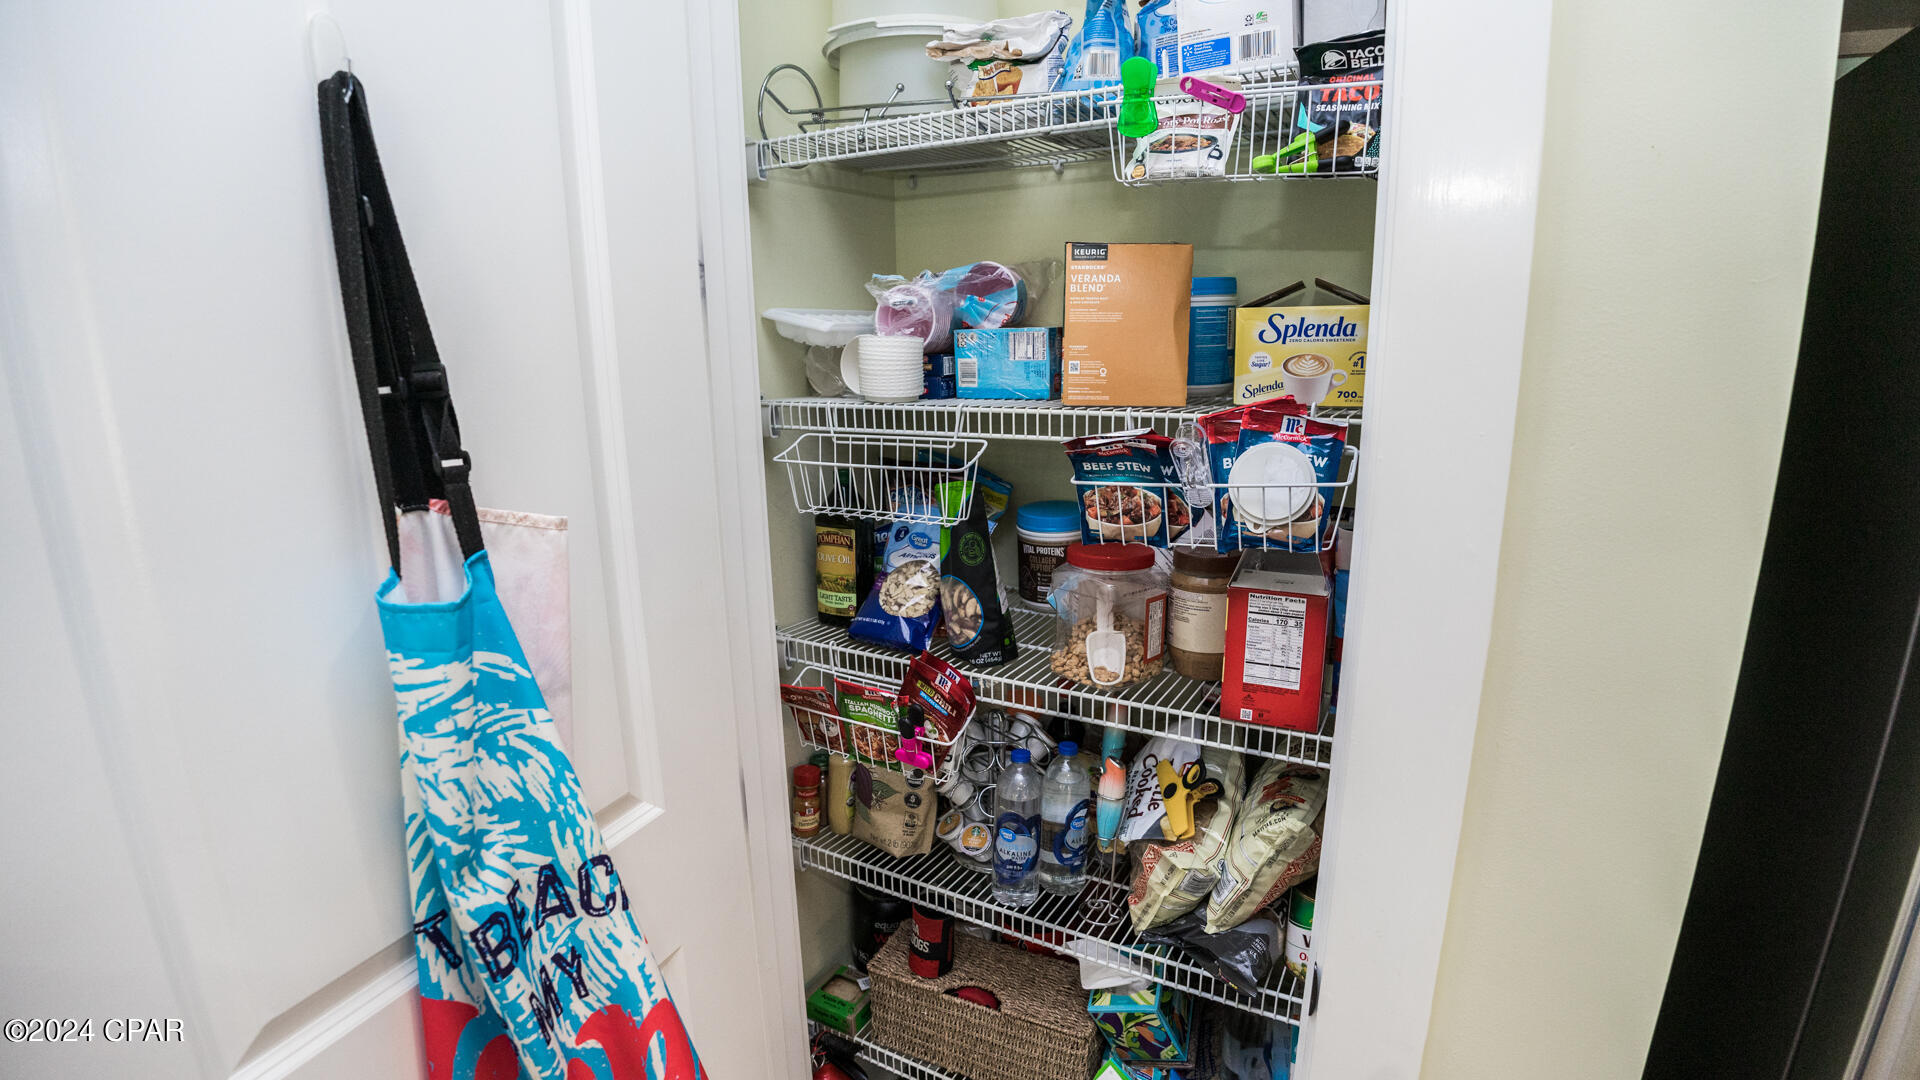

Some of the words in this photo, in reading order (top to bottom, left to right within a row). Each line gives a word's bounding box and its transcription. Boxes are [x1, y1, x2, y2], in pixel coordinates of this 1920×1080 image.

[1347, 45, 1384, 58] TACO
[1351, 58, 1384, 68] BELL
[1329, 73, 1376, 83] ORIGINAL
[1320, 85, 1381, 102] TACO
[1315, 103, 1362, 112] SEASONING
[1070, 273, 1121, 283] VERANDA
[1070, 283, 1104, 292] BLEND
[1258, 313, 1357, 344] Splenda
[1352, 355, 1365, 369] #1
[1242, 380, 1284, 399] Splenda
[1337, 390, 1358, 399] 700
[1274, 433, 1308, 442] McCormick
[1082, 461, 1114, 471] BEEF
[1117, 461, 1151, 473] STEW
[1023, 543, 1035, 554] VITAL
[1036, 544, 1065, 558] PROTEINS
[817, 552, 837, 563] OLIVE
[837, 554, 851, 564] OIL
[1029, 555, 1057, 565] COLLAGEN
[833, 591, 853, 602] TASTE
[1249, 593, 1283, 602] Nutrition
[933, 693, 957, 717] CHILI
[848, 704, 896, 723] SPAGHETTI
[1127, 753, 1159, 820] Cooked
[999, 846, 1032, 857] ALKALINE
[528, 945, 591, 1047] MY
